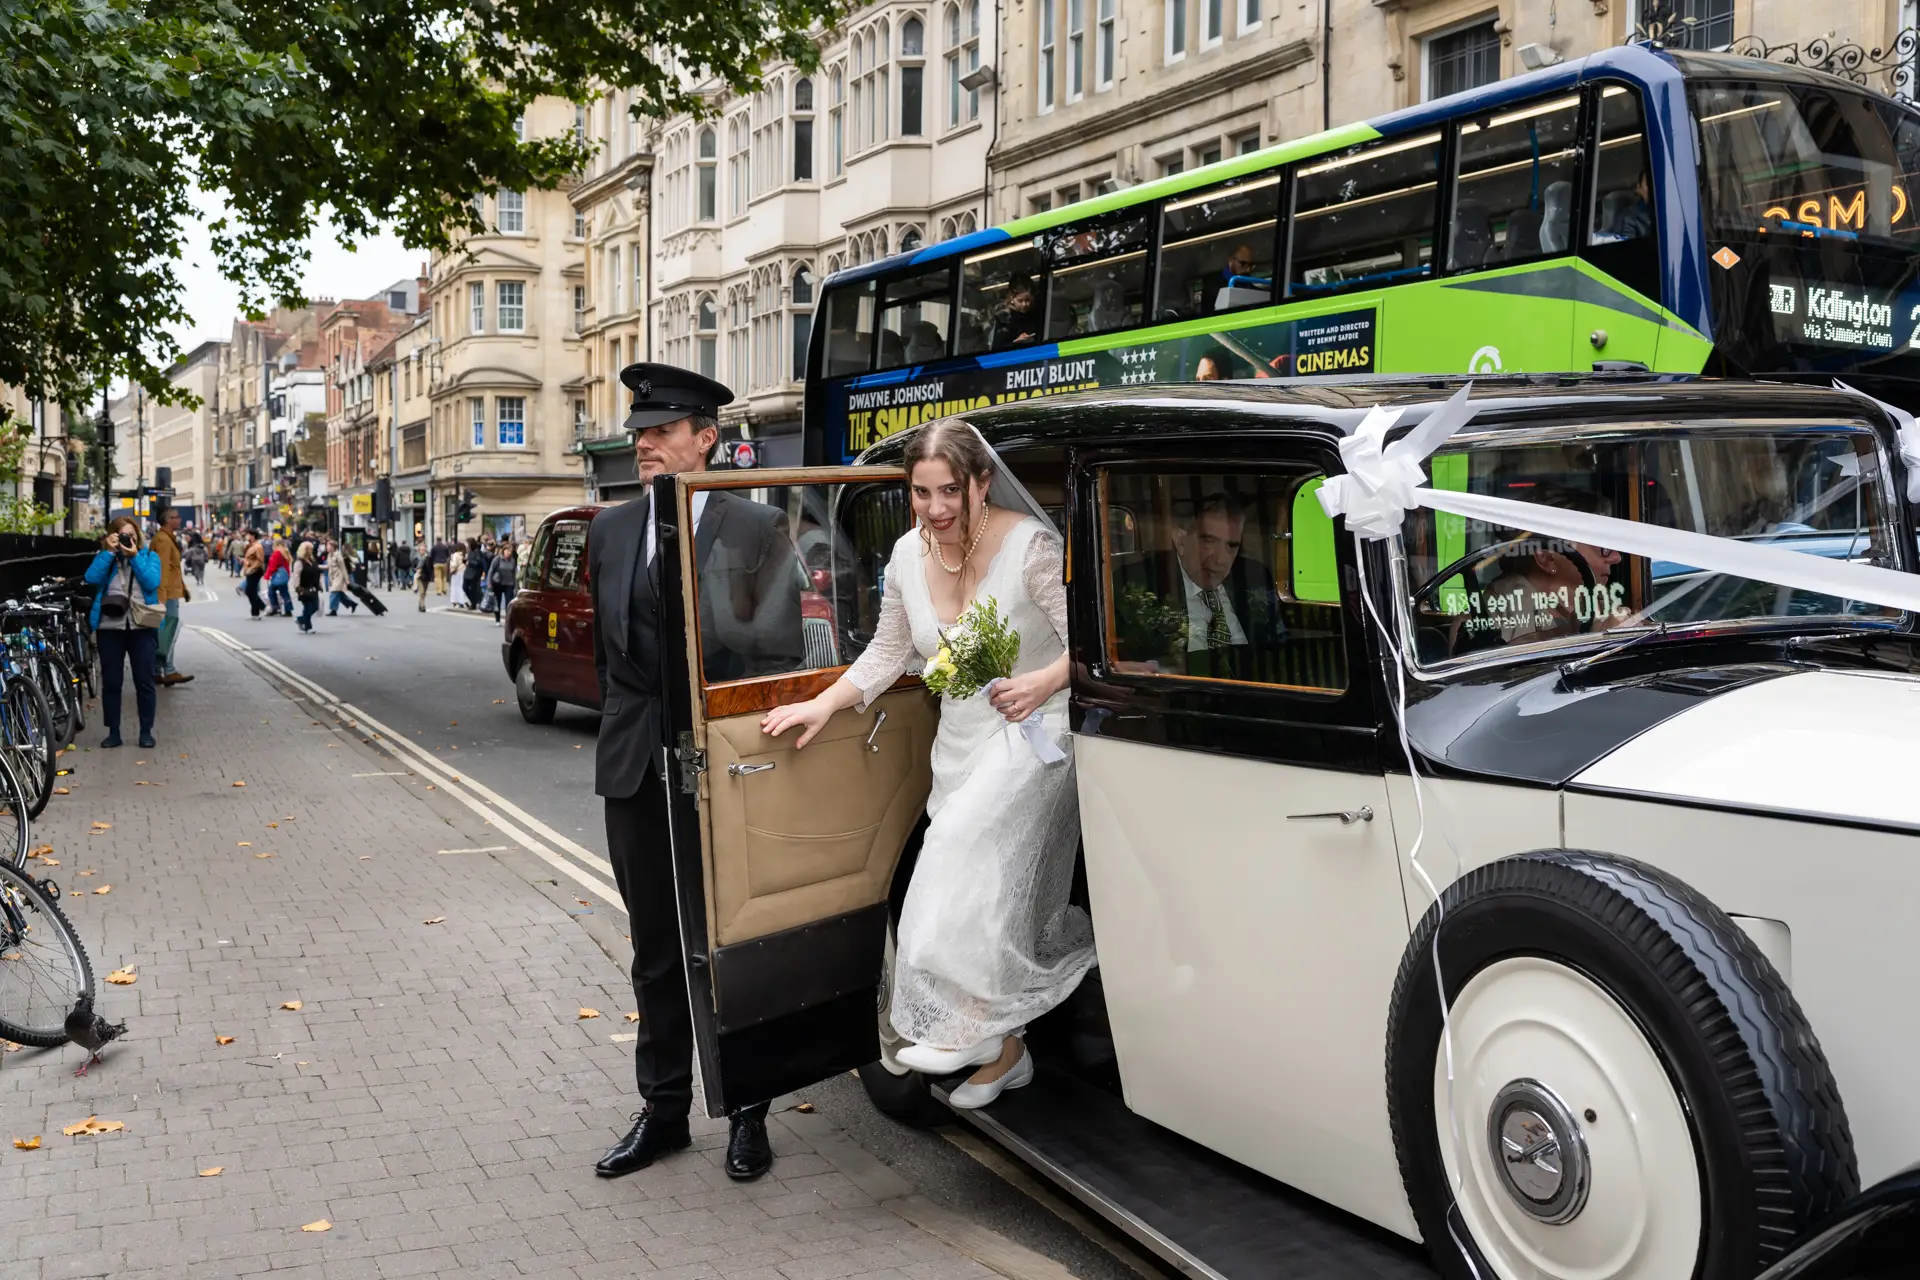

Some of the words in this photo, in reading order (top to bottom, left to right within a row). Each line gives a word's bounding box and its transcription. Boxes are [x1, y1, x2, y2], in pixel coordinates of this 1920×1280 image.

[1808, 287, 1892, 328] Kidlington
[1299, 328, 1325, 338] WRITTEN
[1326, 325, 1339, 334] AND
[1340, 321, 1370, 332] DIRECTED
[1308, 338, 1316, 346] BY
[1317, 335, 1337, 345] BENNY
[1338, 332, 1359, 342] SAFDIE
[1803, 319, 1821, 339] via
[1824, 321, 1892, 347] Summertown
[1006, 367, 1045, 389] EMILY
[1049, 359, 1096, 383] BLUNT
[1296, 346, 1369, 374] CINEMAS
[849, 392, 890, 411] DWAYNE
[892, 382, 945, 405] JOHNSON
[848, 411, 871, 451] THE
